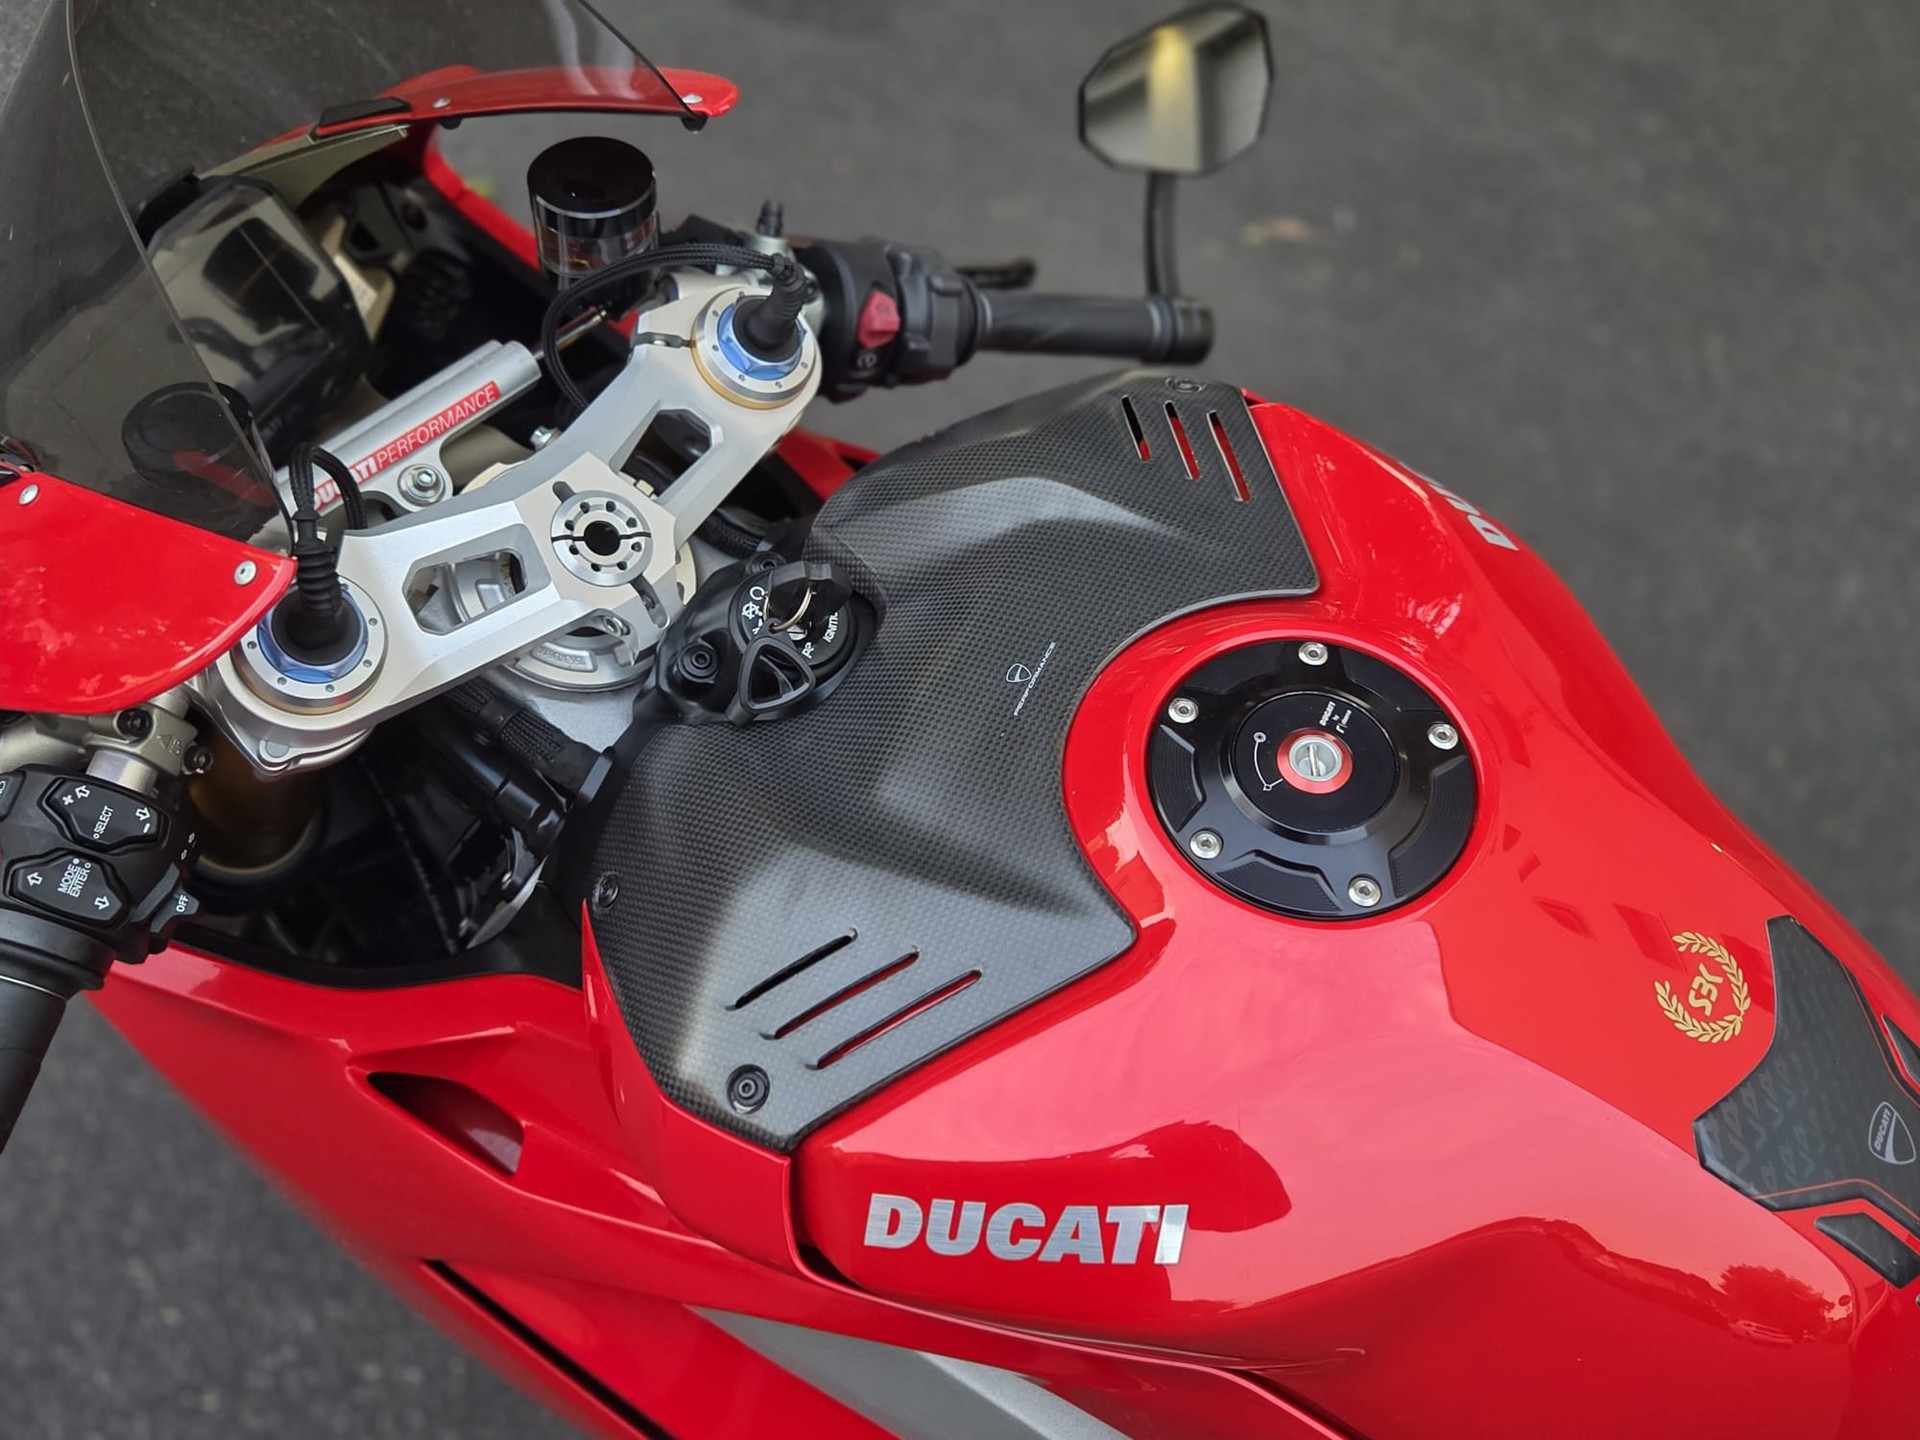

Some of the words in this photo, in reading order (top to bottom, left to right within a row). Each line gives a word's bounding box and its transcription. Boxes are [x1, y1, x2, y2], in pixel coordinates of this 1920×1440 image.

[376, 384, 497, 468] PERFORMANCE
[1013, 641, 1057, 716] PERFORMANCE
[94, 805, 114, 835] SELECT
[57, 863, 80, 894] MODE
[69, 868, 91, 898] ENTER
[175, 894, 190, 913] OFF
[1688, 962, 1724, 1017] SBK
[1873, 1108, 1893, 1152] DUCATI
[863, 1192, 1190, 1265] DUCATI
